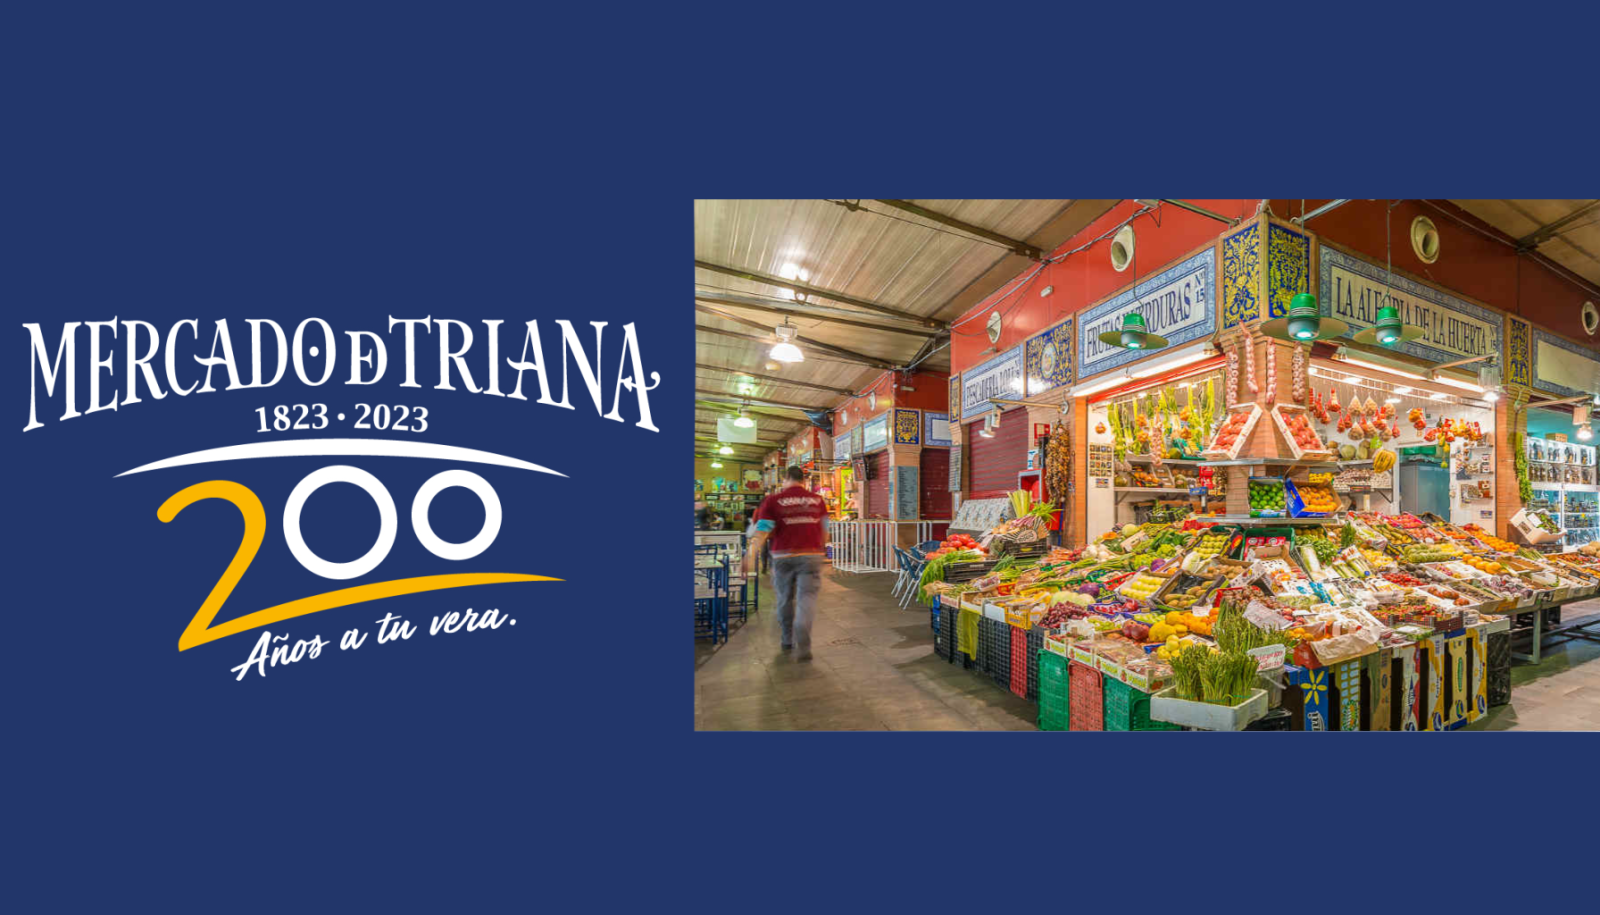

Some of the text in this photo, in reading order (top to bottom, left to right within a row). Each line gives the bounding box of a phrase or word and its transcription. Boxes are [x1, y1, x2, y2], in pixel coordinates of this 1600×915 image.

[1129, 282, 1191, 333] RDURAS
[1336, 277, 1355, 318] LA
[1415, 305, 1430, 342] DE
[1433, 311, 1446, 346] LA
[1448, 317, 1487, 356] HUERTA
